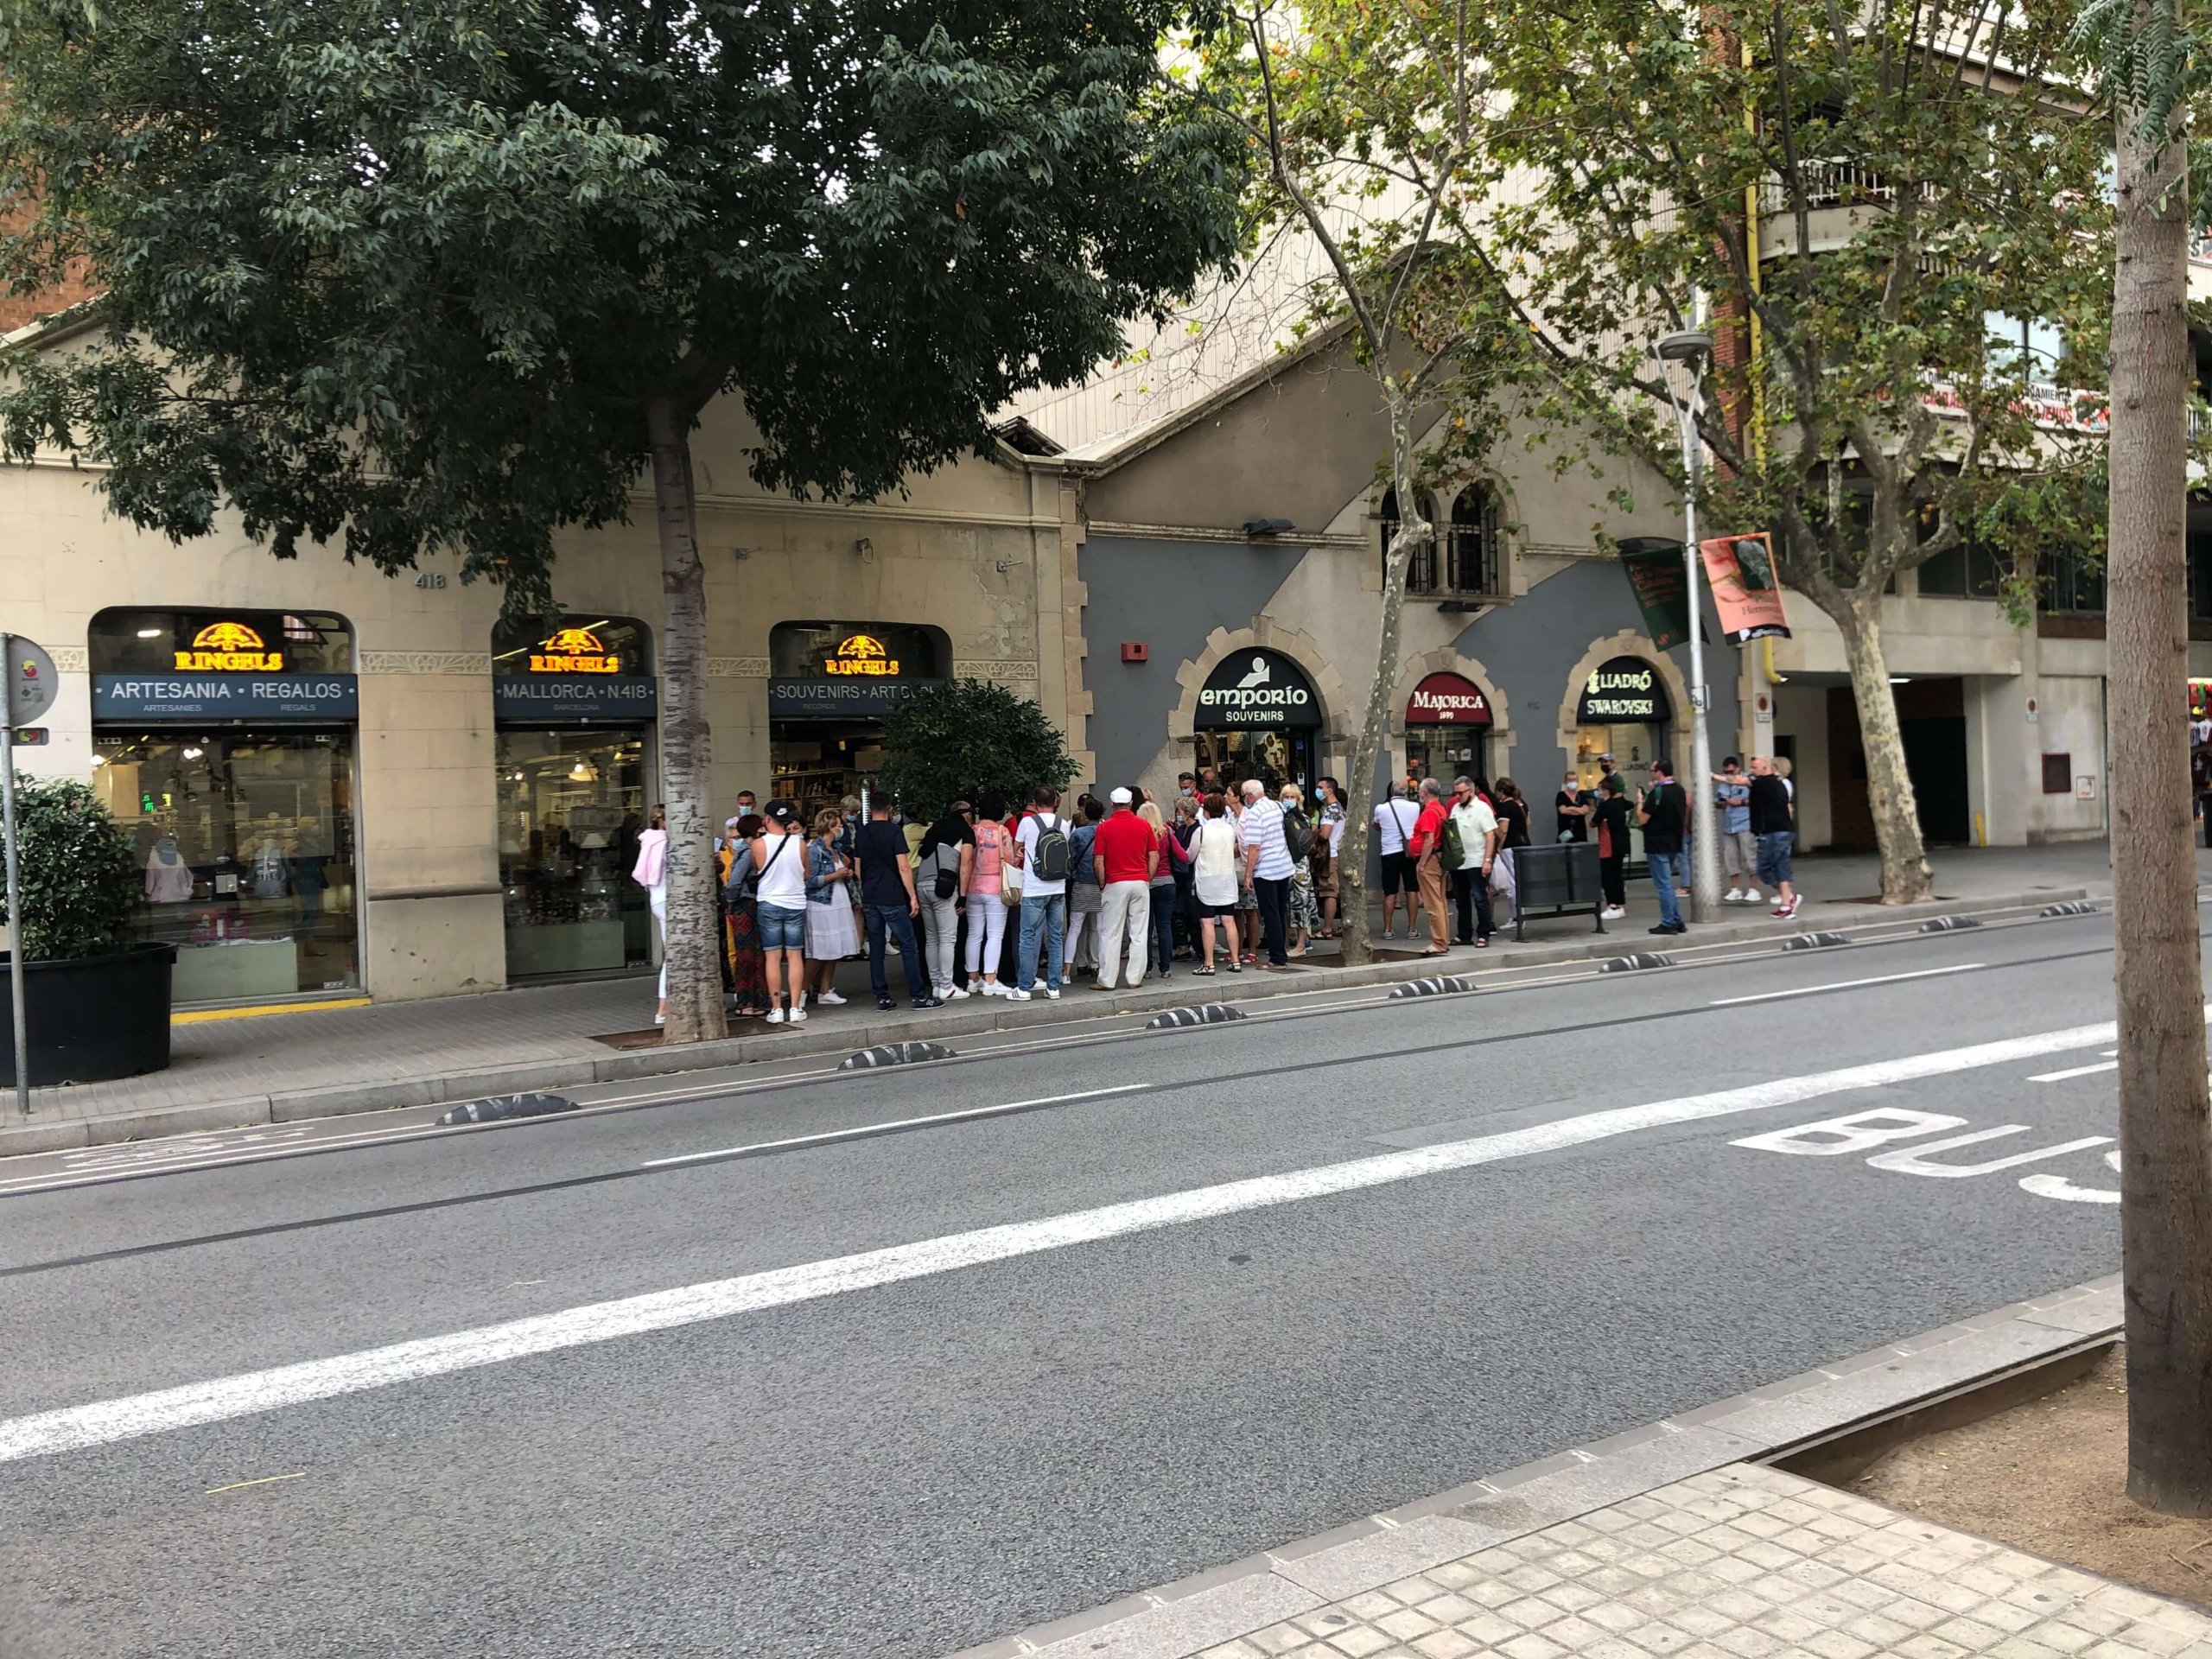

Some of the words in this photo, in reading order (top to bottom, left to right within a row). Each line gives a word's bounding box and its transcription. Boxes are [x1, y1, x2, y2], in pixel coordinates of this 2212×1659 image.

[415, 573, 444, 588] 418
[174, 652, 283, 671] RINGELS
[529, 655, 620, 673] RINGELS
[825, 659, 899, 675] RINGELS
[1600, 670, 1652, 691] LLADRÓ
[111, 682, 232, 699] ARTESANIA
[251, 682, 341, 699] REGALOS
[503, 683, 597, 699] MALLORCA
[777, 684, 860, 699] SOUVENIRS
[869, 685, 898, 699] ART
[280, 703, 316, 712] REGALS
[1586, 699, 1653, 715] SWAROVSKI
[1225, 710, 1284, 721] SOUVENIRS
[1439, 711, 1454, 720] 1890
